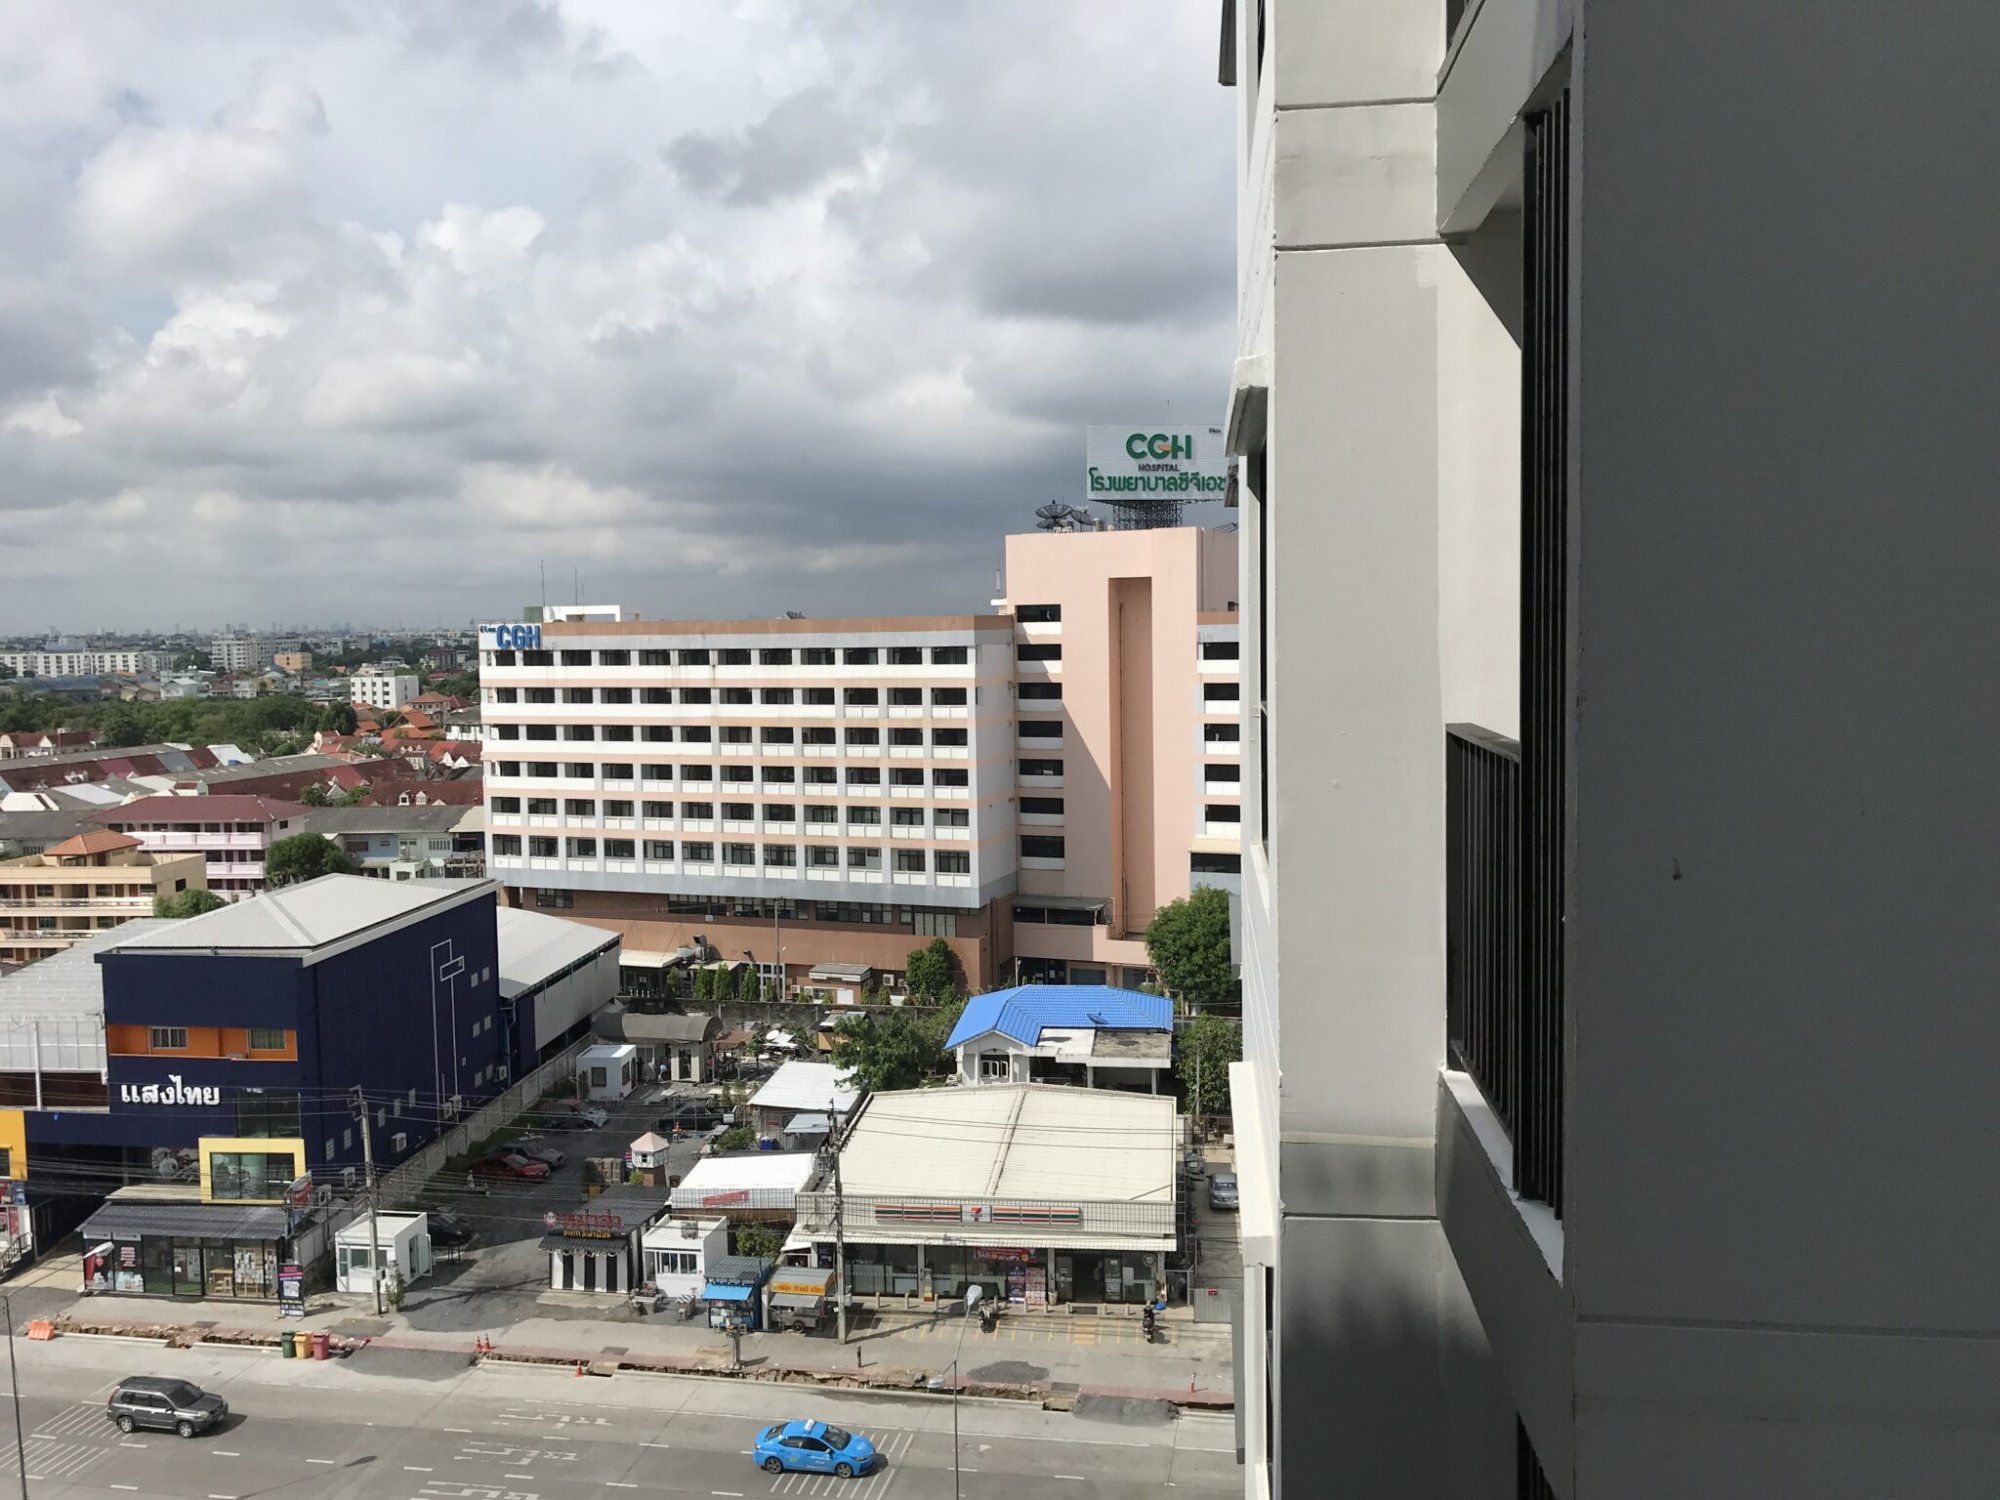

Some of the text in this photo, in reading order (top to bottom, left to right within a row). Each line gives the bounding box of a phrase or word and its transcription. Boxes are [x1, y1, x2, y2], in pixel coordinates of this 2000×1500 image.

[1126, 433, 1192, 460] CGH
[1138, 464, 1180, 472] HOSPITAL
[497, 624, 541, 650] CGH
[121, 1074, 220, 1106] แสงไทย
